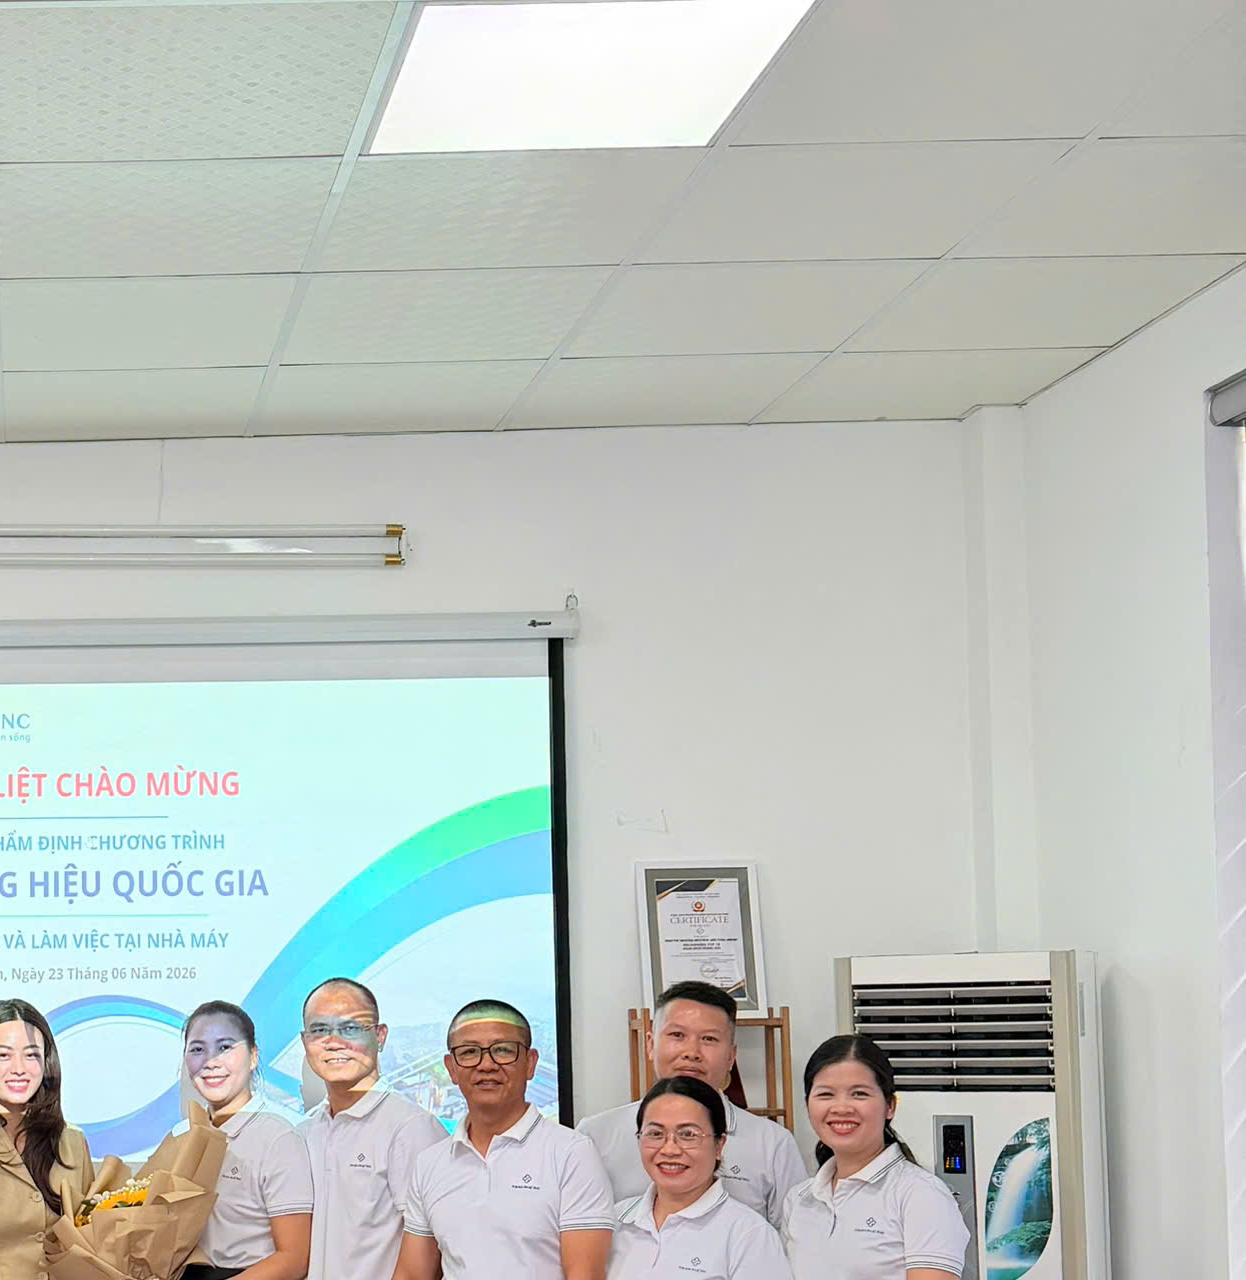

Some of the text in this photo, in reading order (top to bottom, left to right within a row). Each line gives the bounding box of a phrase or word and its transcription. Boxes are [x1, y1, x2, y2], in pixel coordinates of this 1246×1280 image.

[56, 765, 137, 797] CHÀO
[146, 765, 240, 797] MỪNG
[38, 835, 82, 854] ĐỊNH
[88, 834, 166, 850] CHƯƠNG
[171, 829, 225, 850] TRÌNH
[28, 863, 101, 905] HIỆU
[112, 861, 204, 903] QUỐC
[215, 869, 269, 897] GIA
[669, 916, 729, 925] CERTIFICATE
[3, 929, 26, 949] VÀ
[31, 929, 67, 949] LÀM
[72, 928, 110, 952] VIỆC
[114, 933, 141, 952] TẠI
[147, 928, 185, 948] NHÀ
[191, 928, 229, 948] MÁY
[11, 967, 45, 984] Ngày
[48, 967, 64, 980] 23
[67, 966, 108, 983] Tháng
[111, 967, 127, 980] 06
[130, 966, 162, 980] Năm
[166, 967, 197, 980] 2026
